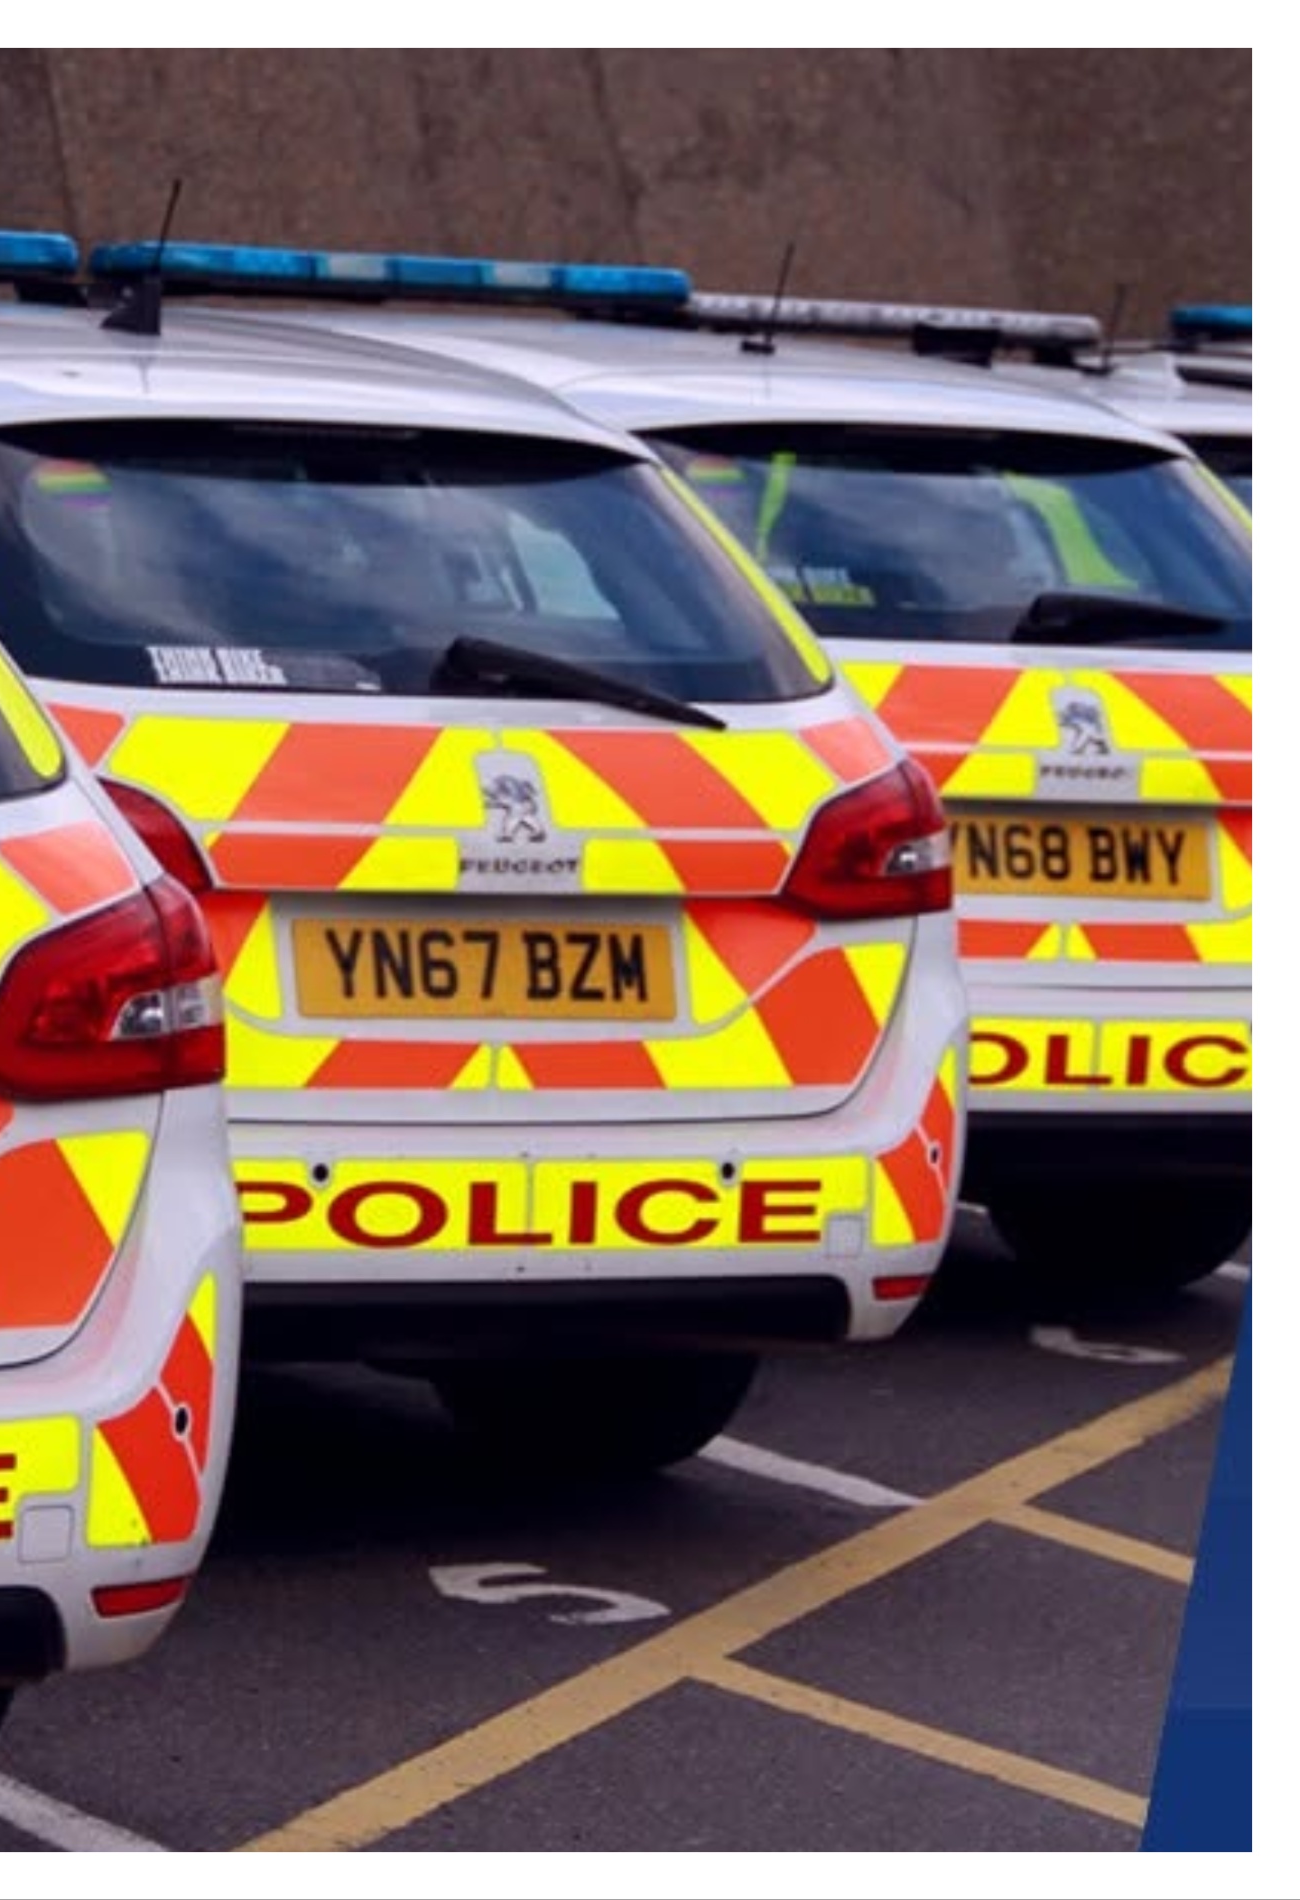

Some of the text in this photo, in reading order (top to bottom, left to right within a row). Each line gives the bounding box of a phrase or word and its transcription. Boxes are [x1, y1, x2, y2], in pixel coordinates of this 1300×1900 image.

[459, 858, 581, 873] PEUGEOT
[1087, 826, 1185, 885] BWY
[325, 929, 648, 1003] YN67 BZM
[235, 1179, 821, 1247] POLICE
[428, 1562, 671, 1625] 5
